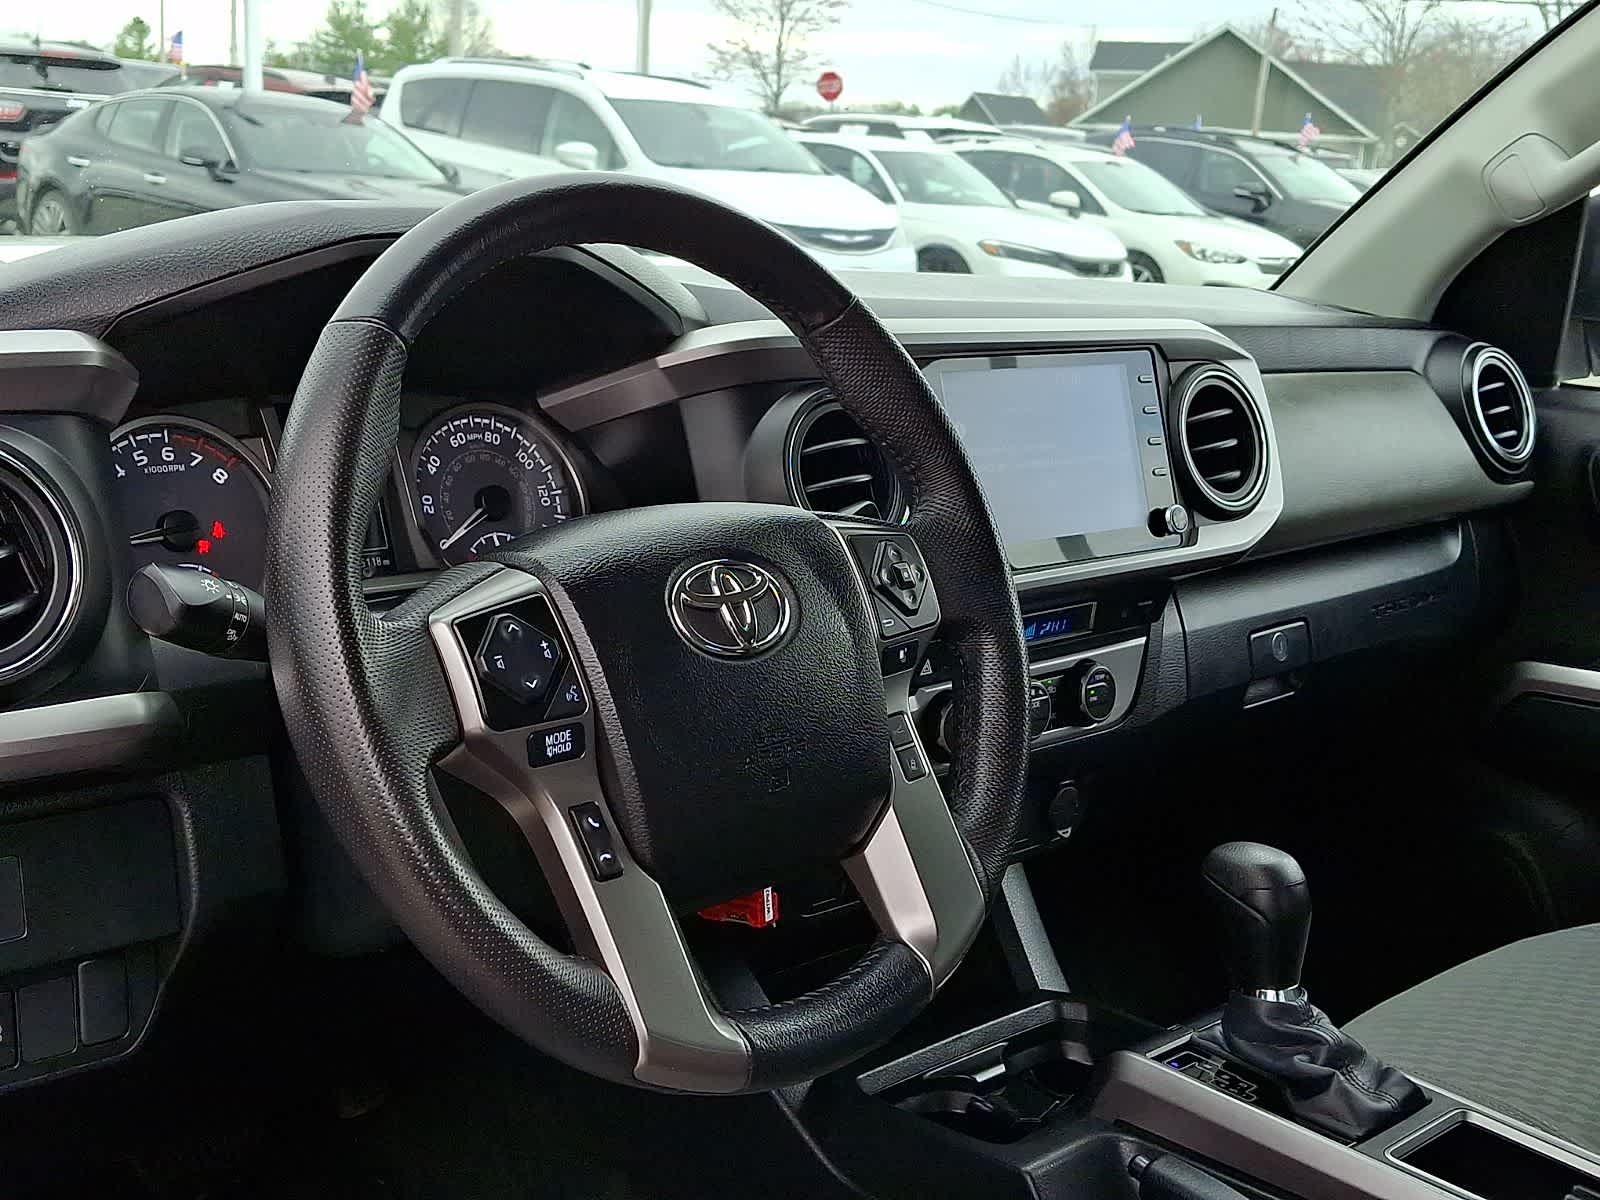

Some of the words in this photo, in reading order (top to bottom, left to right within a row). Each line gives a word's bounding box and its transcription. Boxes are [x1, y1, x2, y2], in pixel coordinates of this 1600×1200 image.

[450, 433, 466, 447] 60
[466, 433, 483, 441] MPH
[484, 432, 500, 445] 80
[132, 450, 148, 466] 5
[162, 446, 175, 461] 6
[190, 452, 203, 466] 7
[516, 449, 534, 469] 100
[427, 456, 440, 474] 40
[212, 468, 228, 484] 8
[537, 485, 550, 505] 120
[422, 495, 435, 514] 20
[546, 730, 572, 746] MODE
[553, 742, 571, 755] HOLD
